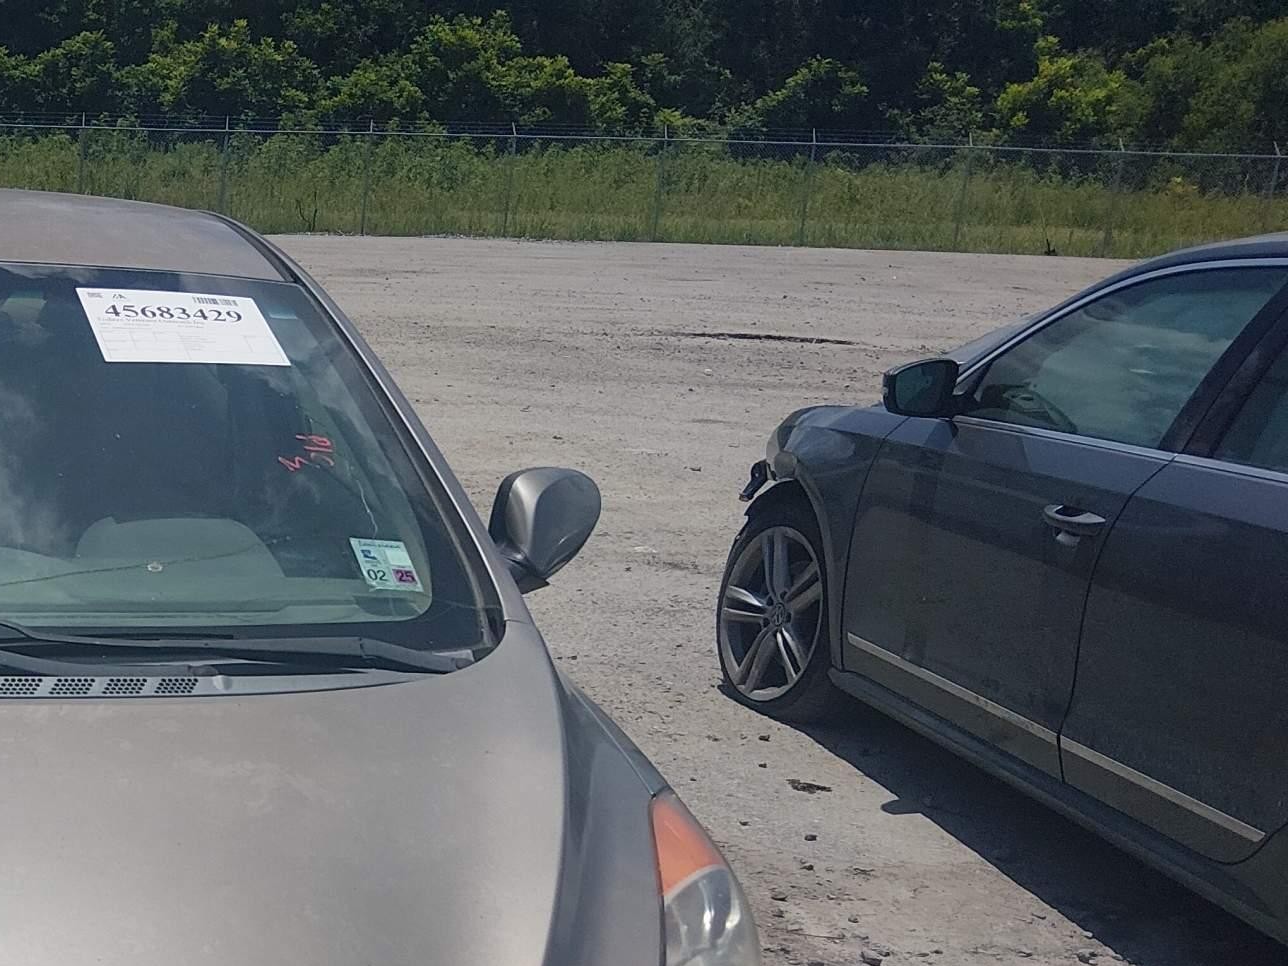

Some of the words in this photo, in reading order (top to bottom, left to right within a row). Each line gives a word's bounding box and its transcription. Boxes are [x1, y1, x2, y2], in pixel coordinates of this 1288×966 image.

[105, 303, 242, 323] 45683429
[367, 568, 388, 581] 02
[396, 570, 416, 583] 25
